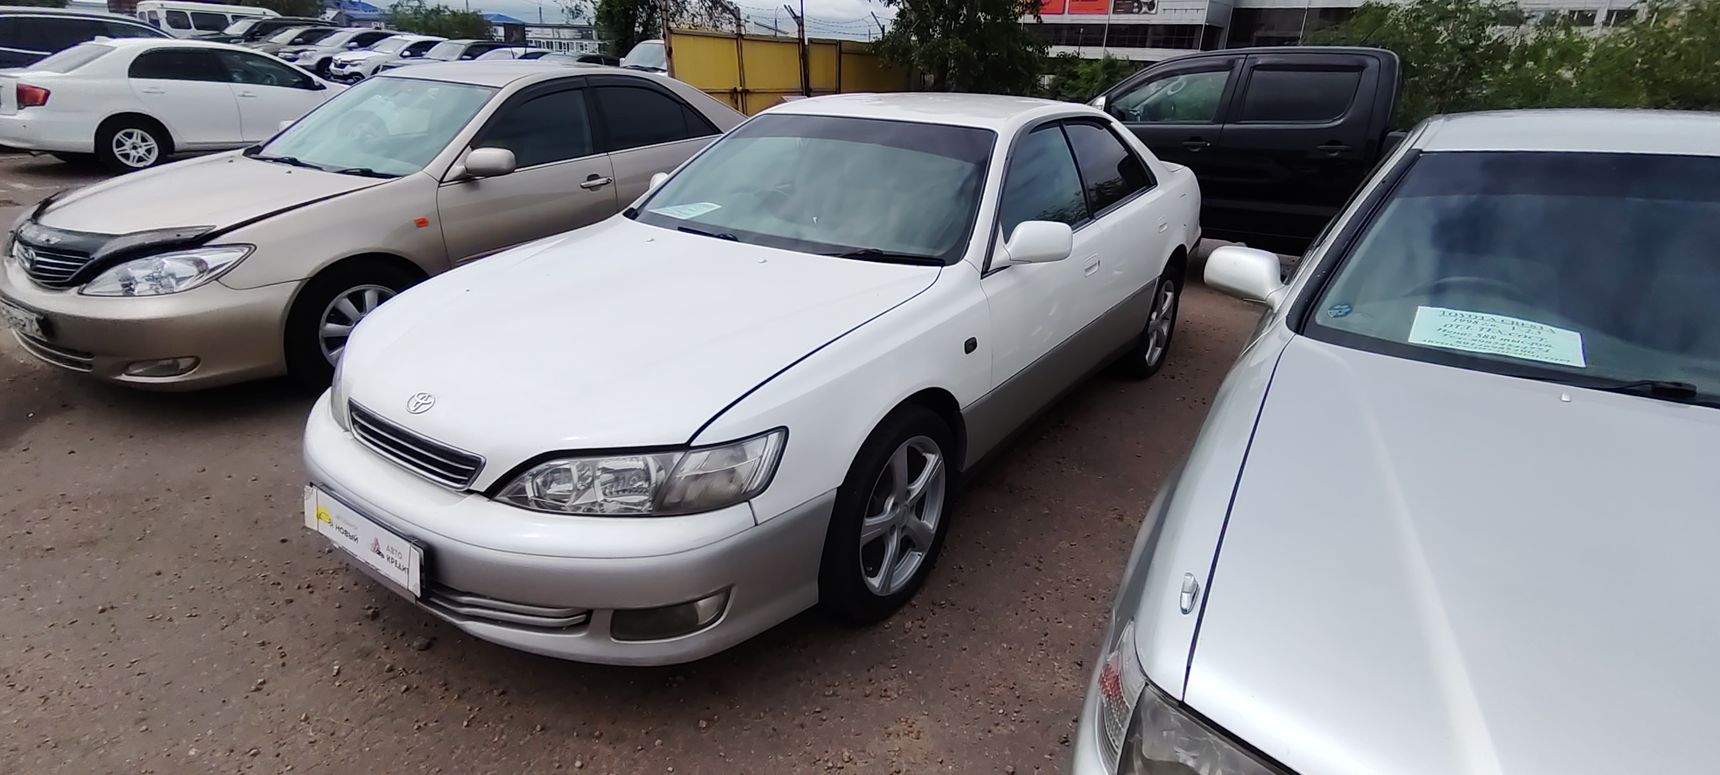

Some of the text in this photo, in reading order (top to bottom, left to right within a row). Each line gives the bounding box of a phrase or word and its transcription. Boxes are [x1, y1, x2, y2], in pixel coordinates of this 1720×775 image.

[1440, 310, 1556, 334] TOYOTA CRESTA
[336, 524, 359, 544] НОВЫЙ
[386, 545, 403, 560] АВТО
